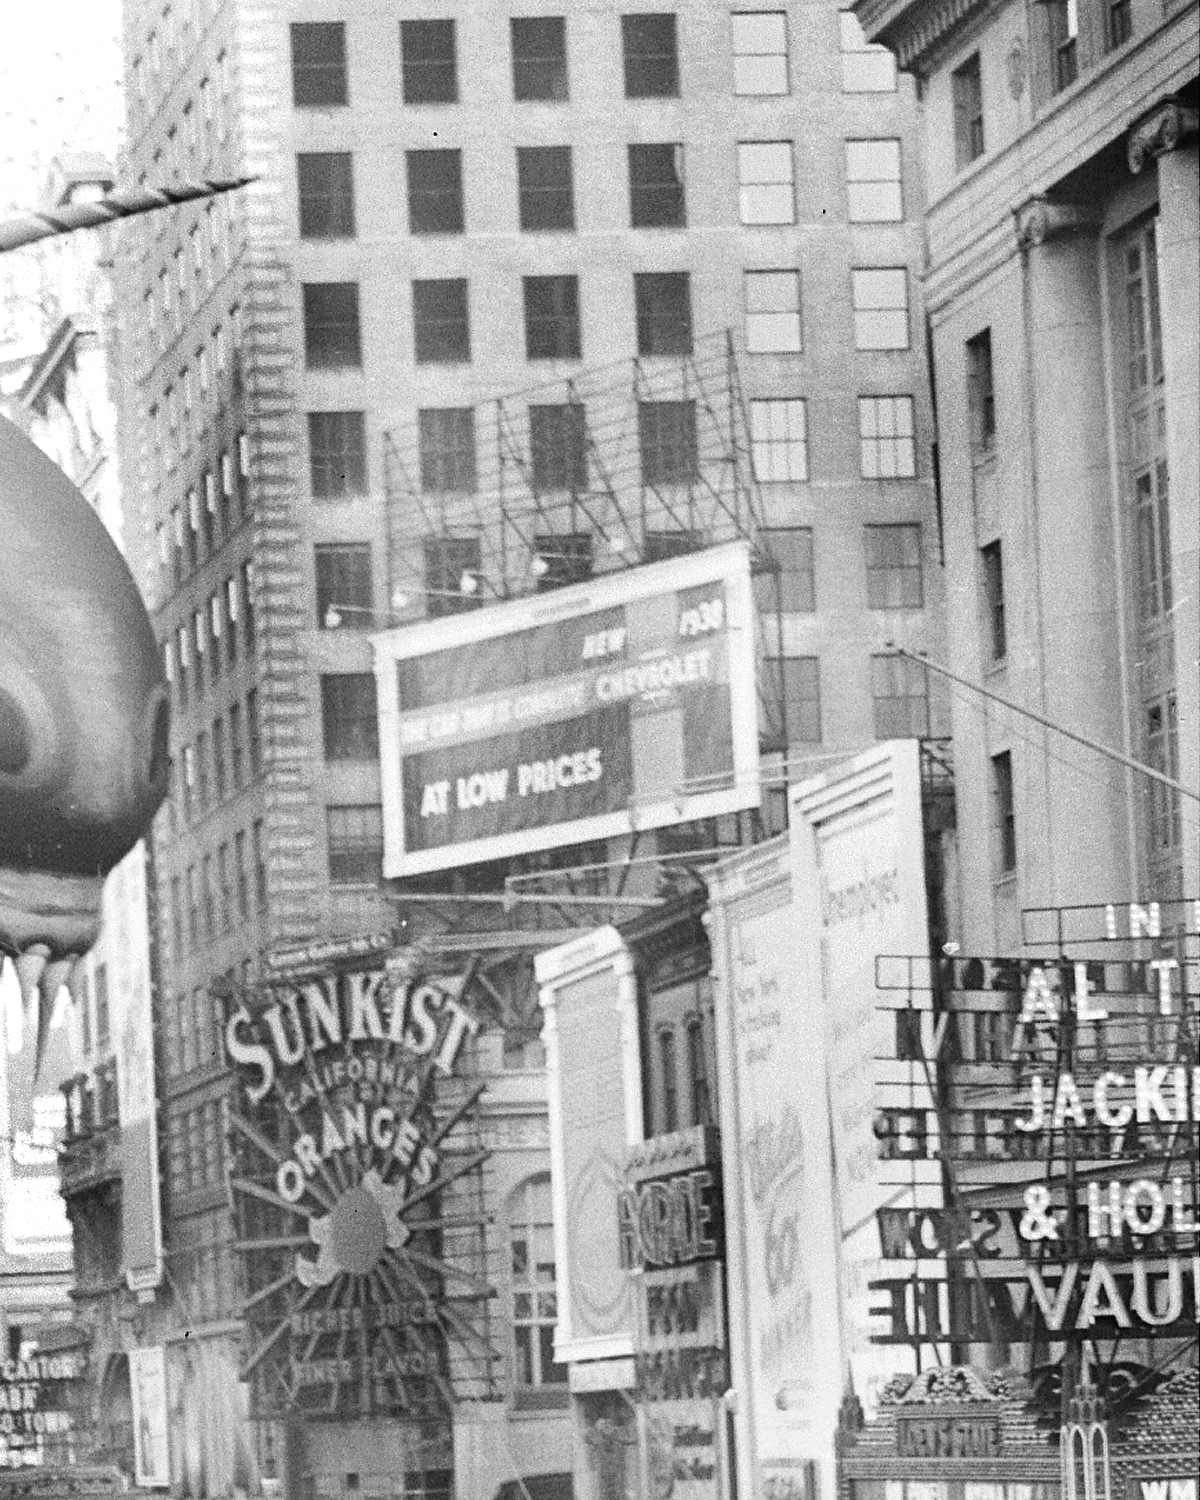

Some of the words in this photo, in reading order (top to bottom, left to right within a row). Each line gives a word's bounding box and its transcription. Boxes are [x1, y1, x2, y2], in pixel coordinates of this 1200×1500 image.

[582, 628, 626, 659] NEW
[596, 648, 711, 701] CHEVROLET
[420, 779, 451, 818] AT
[456, 768, 509, 809] LOW
[517, 747, 602, 797] PRICES
[1105, 902, 1161, 939] IN
[1016, 961, 1109, 1023] AL
[225, 970, 479, 1105] SUNKIST
[284, 1057, 420, 1113] CALIFORNIA
[276, 1102, 437, 1202] ORANGES
[1019, 1184, 1060, 1241] &
[1088, 1177, 1199, 1238] HOL
[1026, 1255, 1199, 1331] VAU
